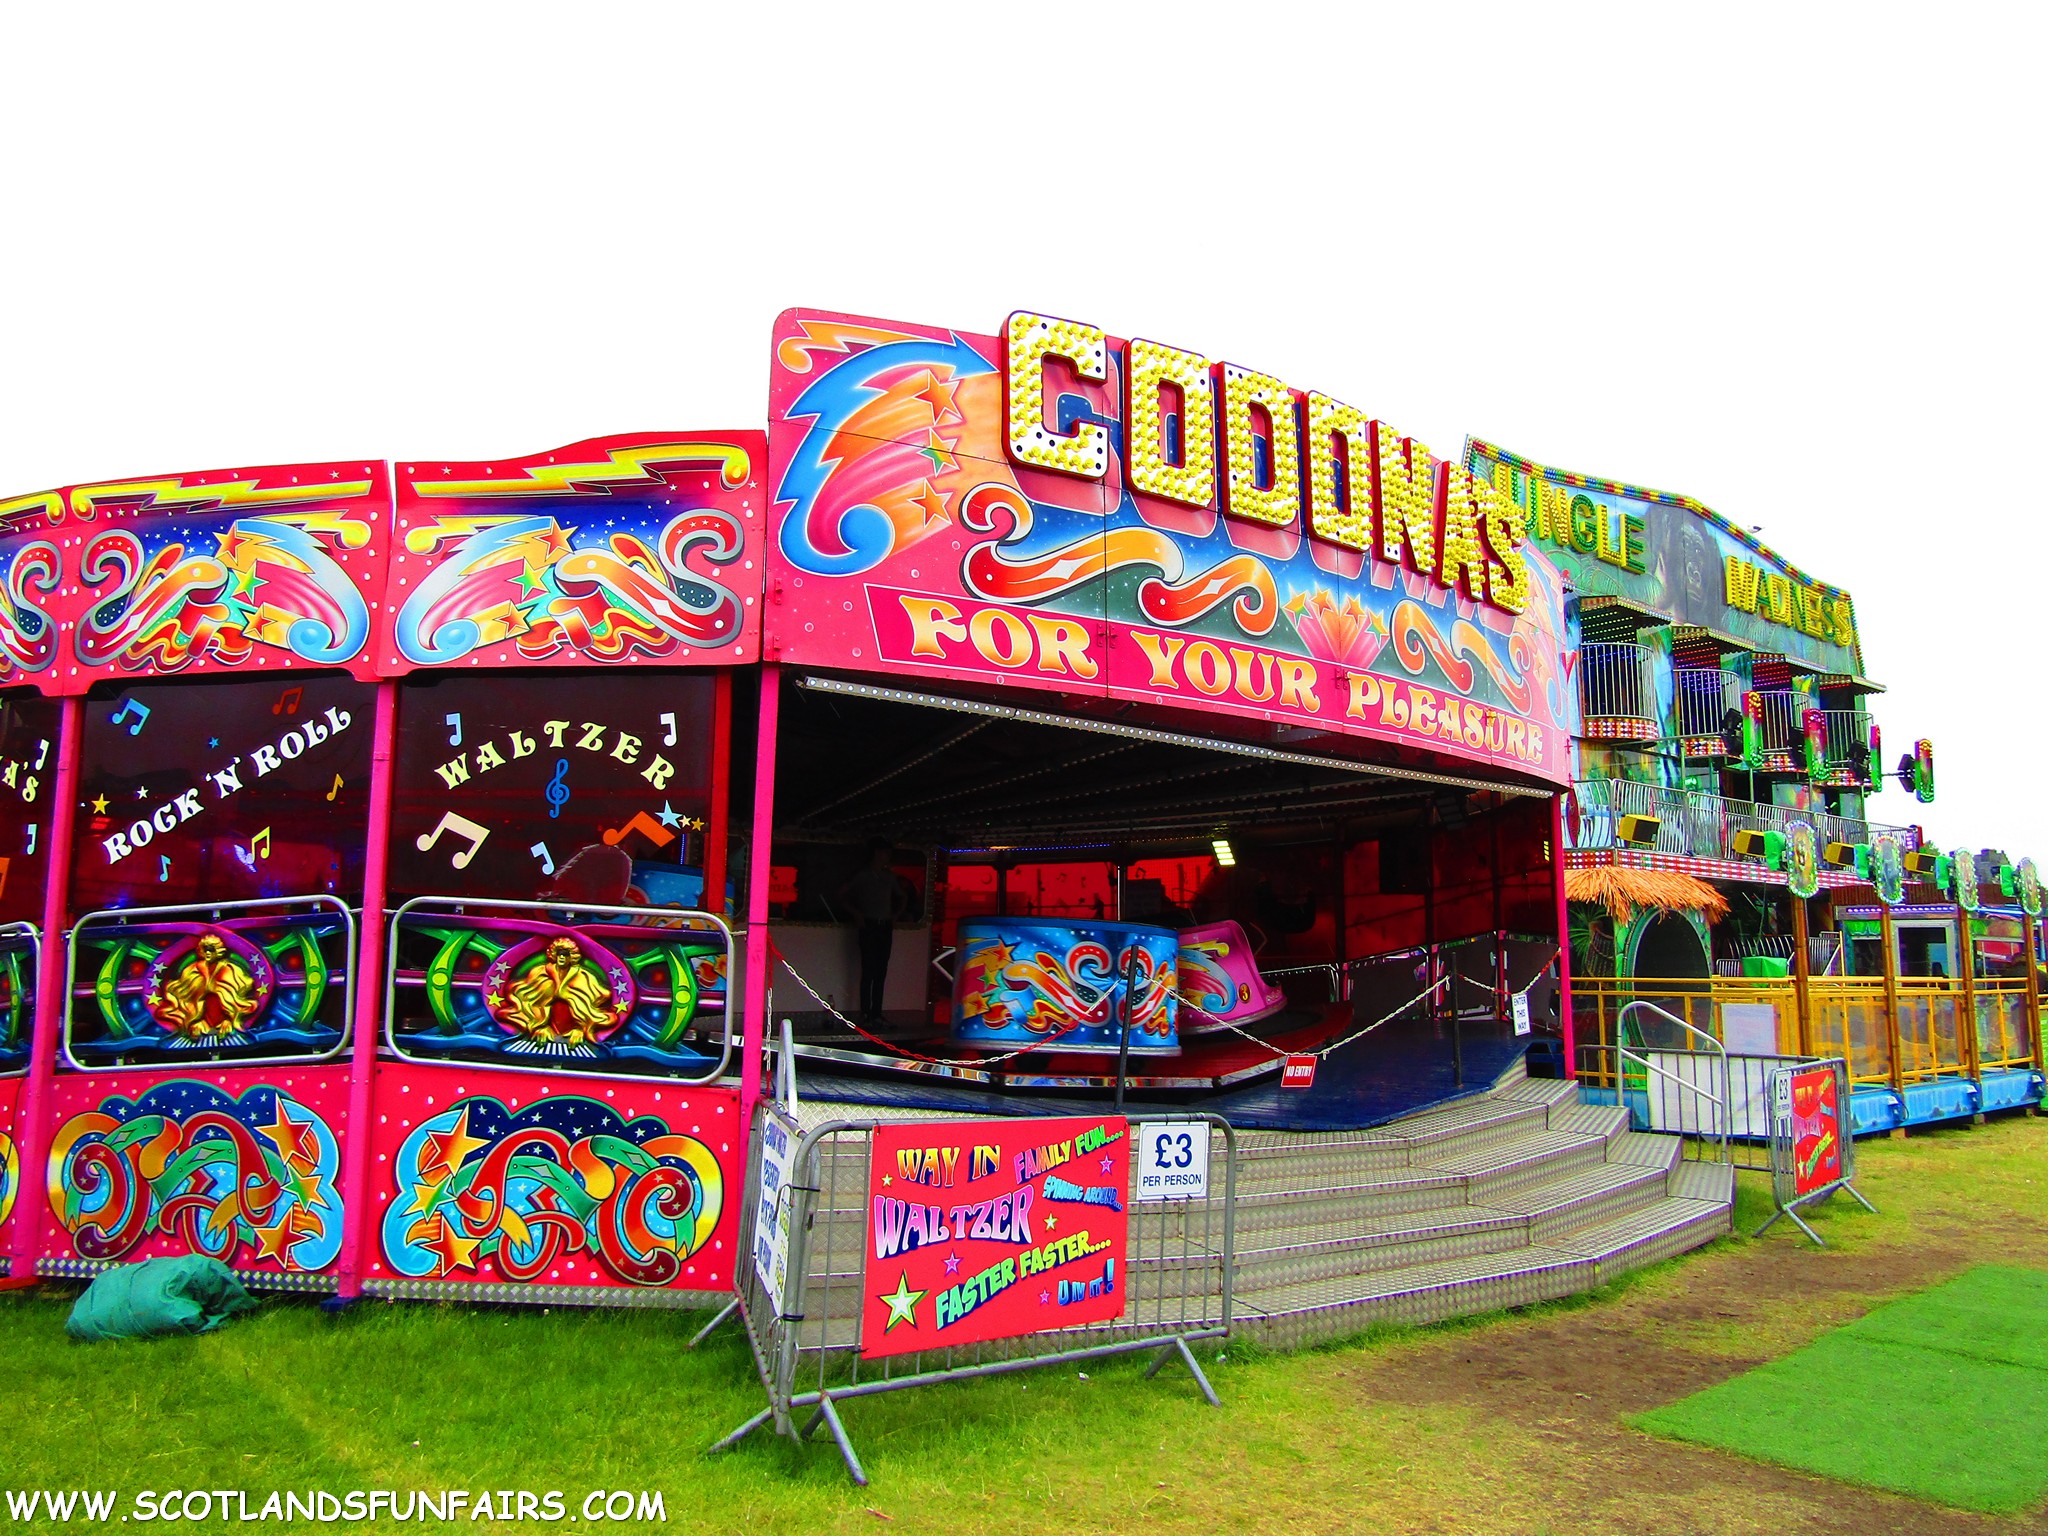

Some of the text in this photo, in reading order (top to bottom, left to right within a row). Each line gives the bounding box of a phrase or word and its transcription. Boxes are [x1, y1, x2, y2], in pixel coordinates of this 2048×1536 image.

[1726, 555, 1851, 647] MADNESS
[899, 595, 1543, 764] FOR YOUR PLEASURE
[434, 720, 675, 790] WALTZER
[0, 755, 39, 802] A'S
[103, 788, 204, 864] ROCK
[251, 706, 352, 777] ROLL
[1294, 1066, 1312, 1077] ENTRY
[896, 1144, 1001, 1187] WAY IN
[1013, 1139, 1071, 1185] FAMILY
[1155, 1133, 1193, 1168] £3
[1042, 1175, 1083, 1201] SPINNING
[1142, 1174, 1202, 1187] PER PERSON
[874, 1184, 1034, 1259] WALTZER
[935, 1257, 1016, 1330] FASTER
[1058, 1279, 1069, 1305] U
[1072, 1281, 1086, 1301] IN
